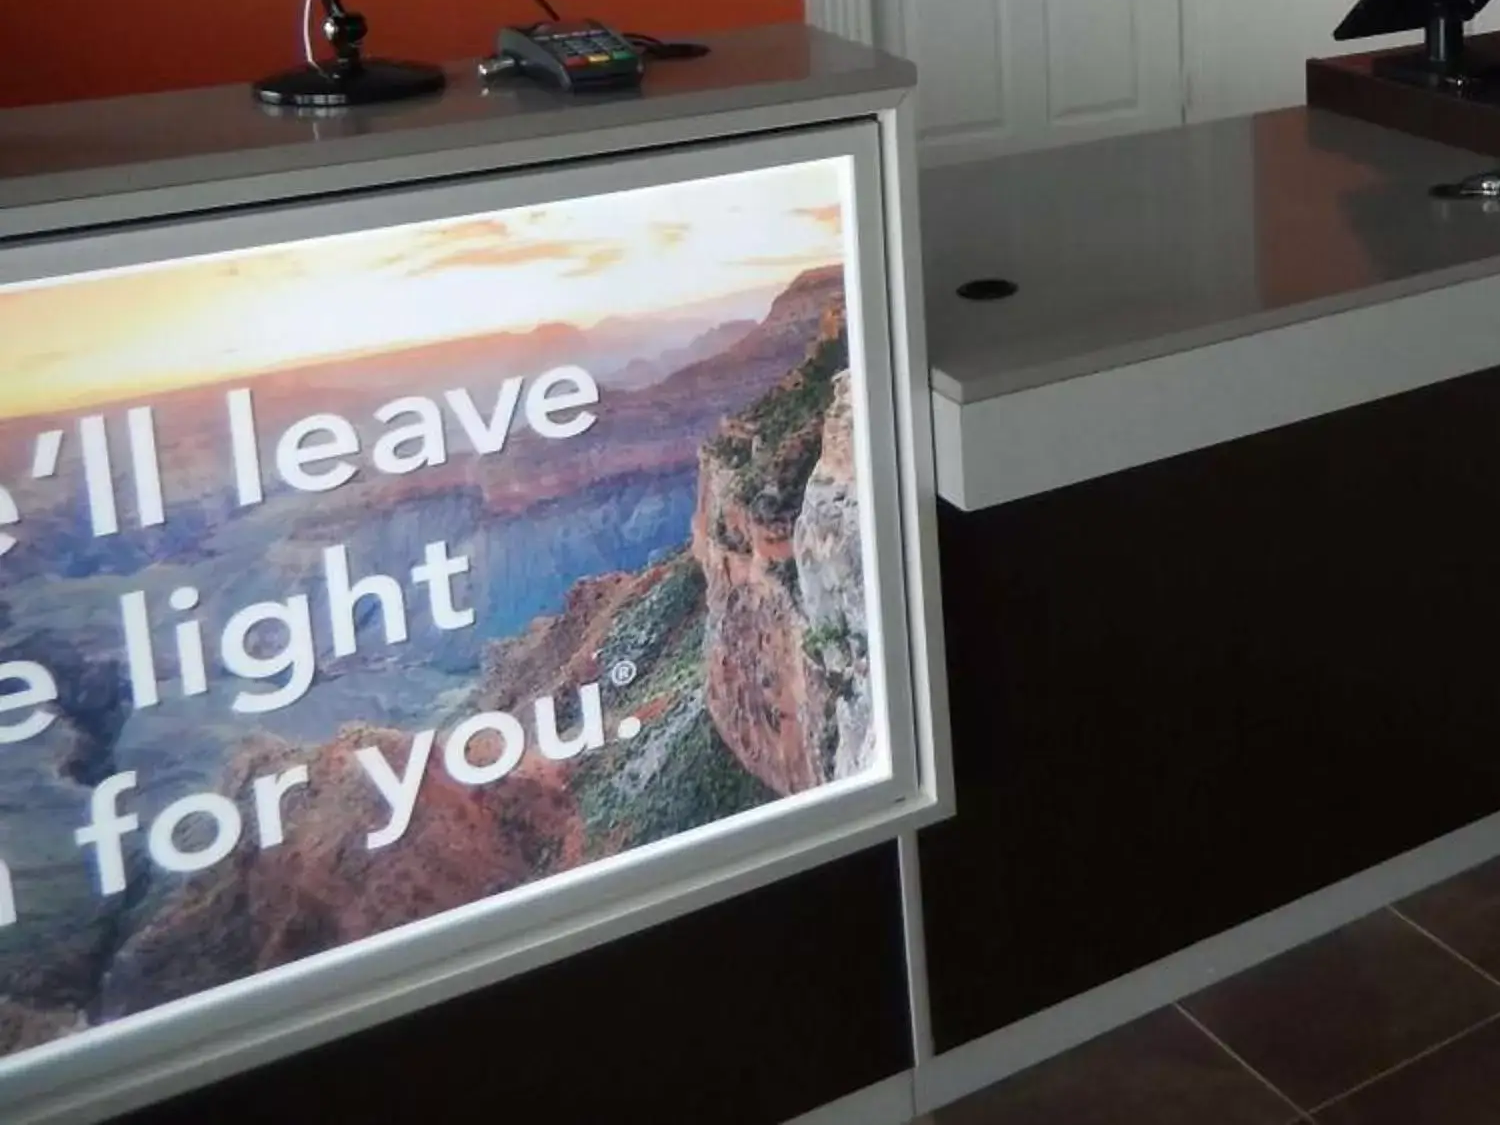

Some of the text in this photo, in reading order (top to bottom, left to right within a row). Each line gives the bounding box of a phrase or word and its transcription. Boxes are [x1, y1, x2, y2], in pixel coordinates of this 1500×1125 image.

[0, 365, 600, 556] 'll leave
[120, 541, 475, 712] light
[76, 768, 308, 896] for
